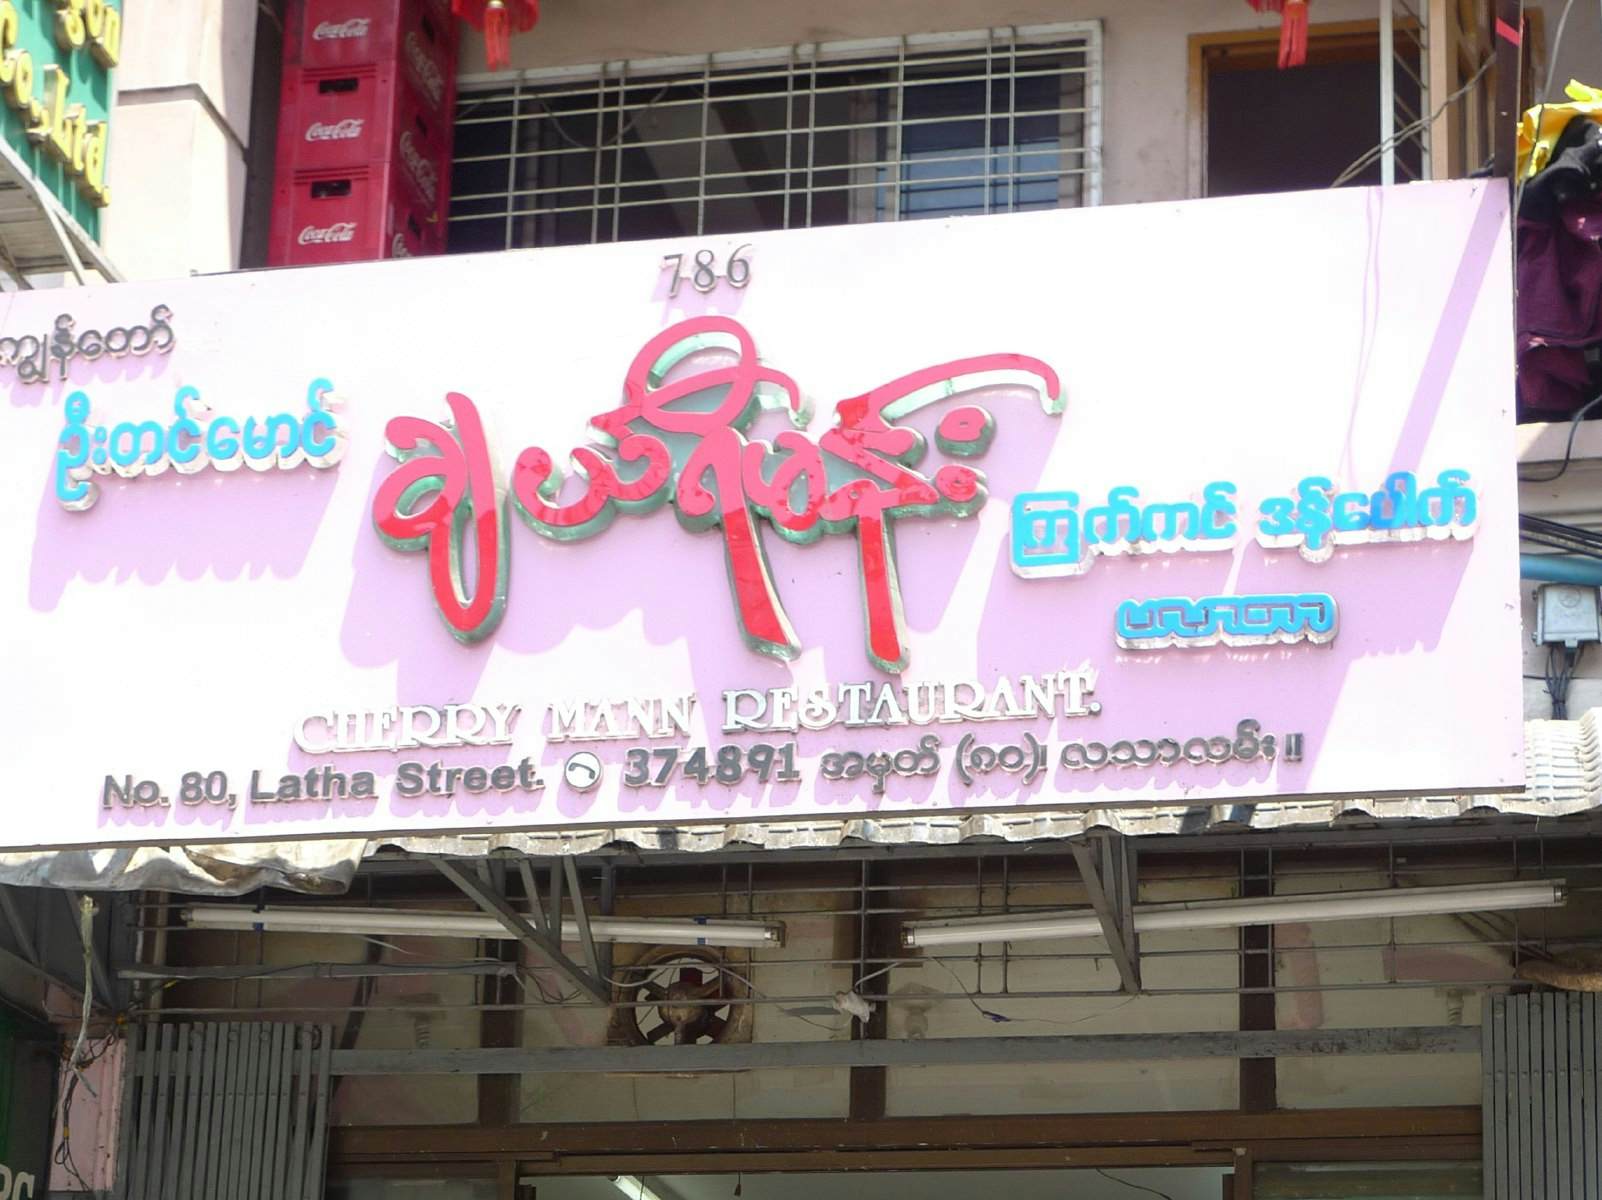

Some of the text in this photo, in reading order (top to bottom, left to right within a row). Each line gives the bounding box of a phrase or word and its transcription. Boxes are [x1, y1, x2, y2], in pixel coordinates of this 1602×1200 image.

[305, 118, 364, 142] Coca-Cola
[298, 222, 357, 245] Coca-Cola
[662, 243, 753, 298] 786
[293, 702, 523, 755] CHERRY
[546, 693, 697, 744] MANN
[102, 773, 171, 809] No.
[179, 770, 238, 811] 80,
[250, 764, 379, 805] Latha
[623, 742, 802, 787] 374891
[820, 732, 941, 794] အမှတ်
